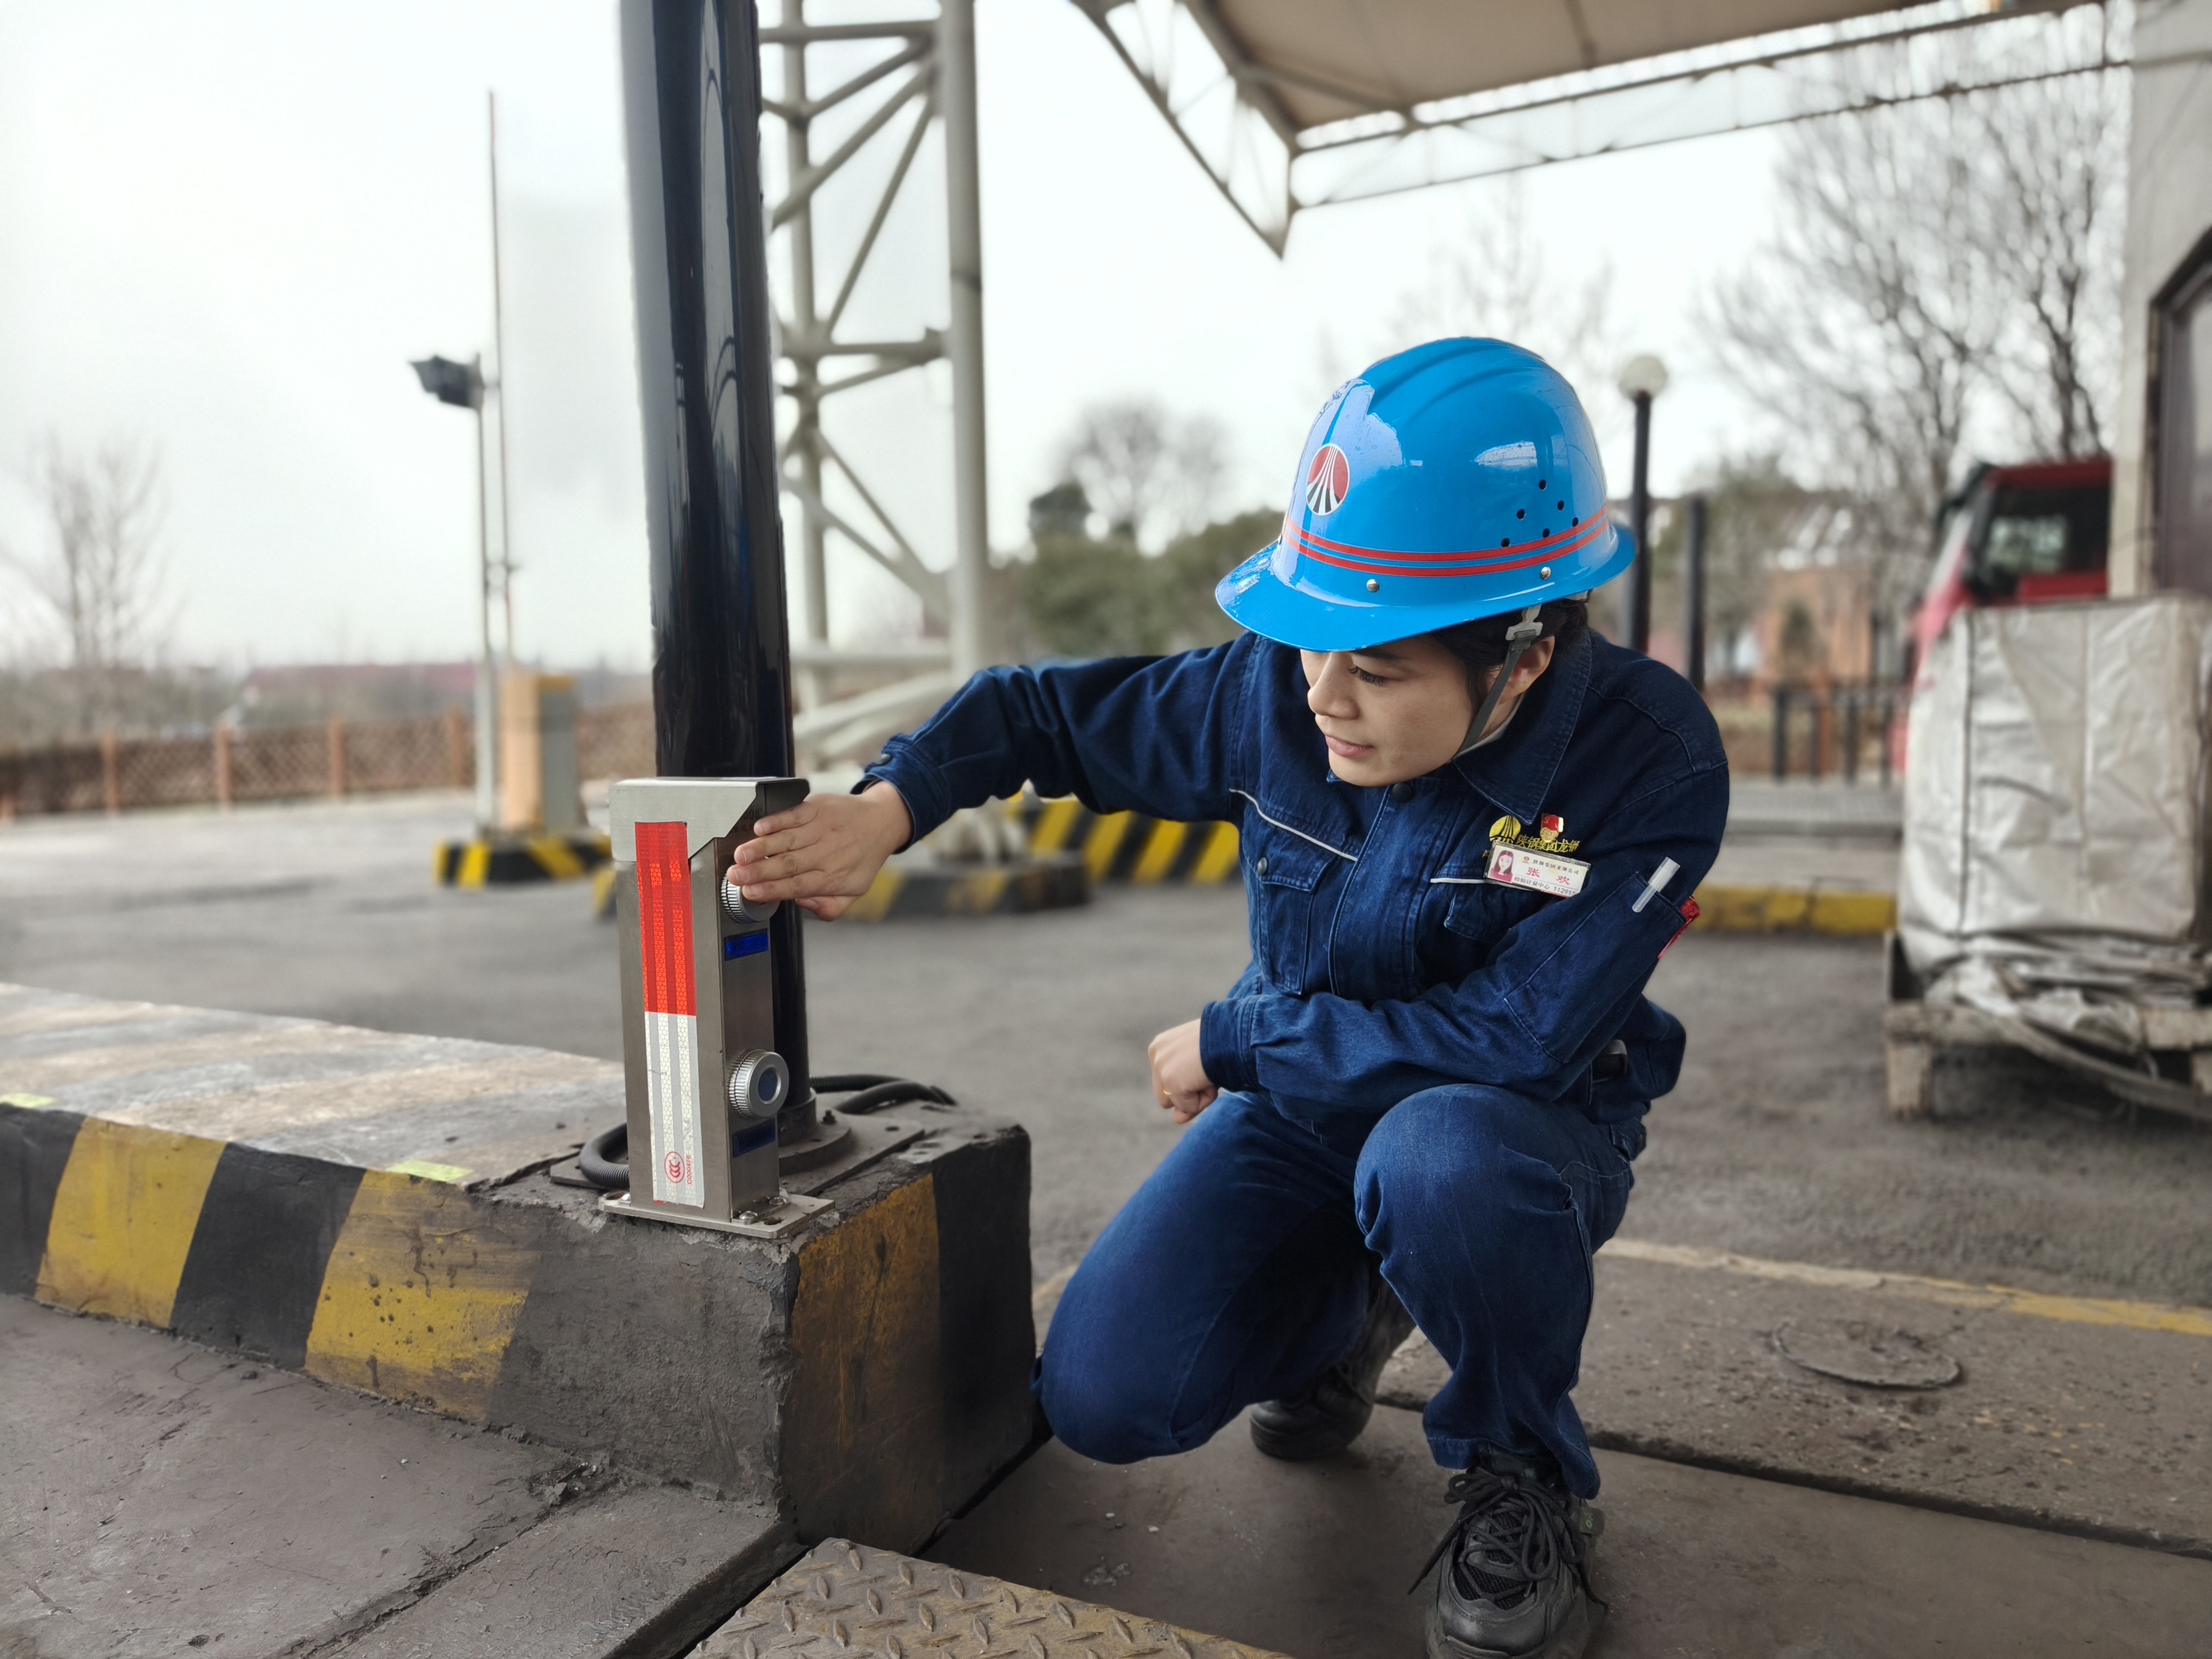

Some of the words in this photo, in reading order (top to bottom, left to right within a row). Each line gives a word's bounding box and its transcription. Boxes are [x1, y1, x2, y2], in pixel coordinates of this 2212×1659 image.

[1514, 876, 1550, 889] 检验计量中心
[1553, 886, 1576, 896] 112915
